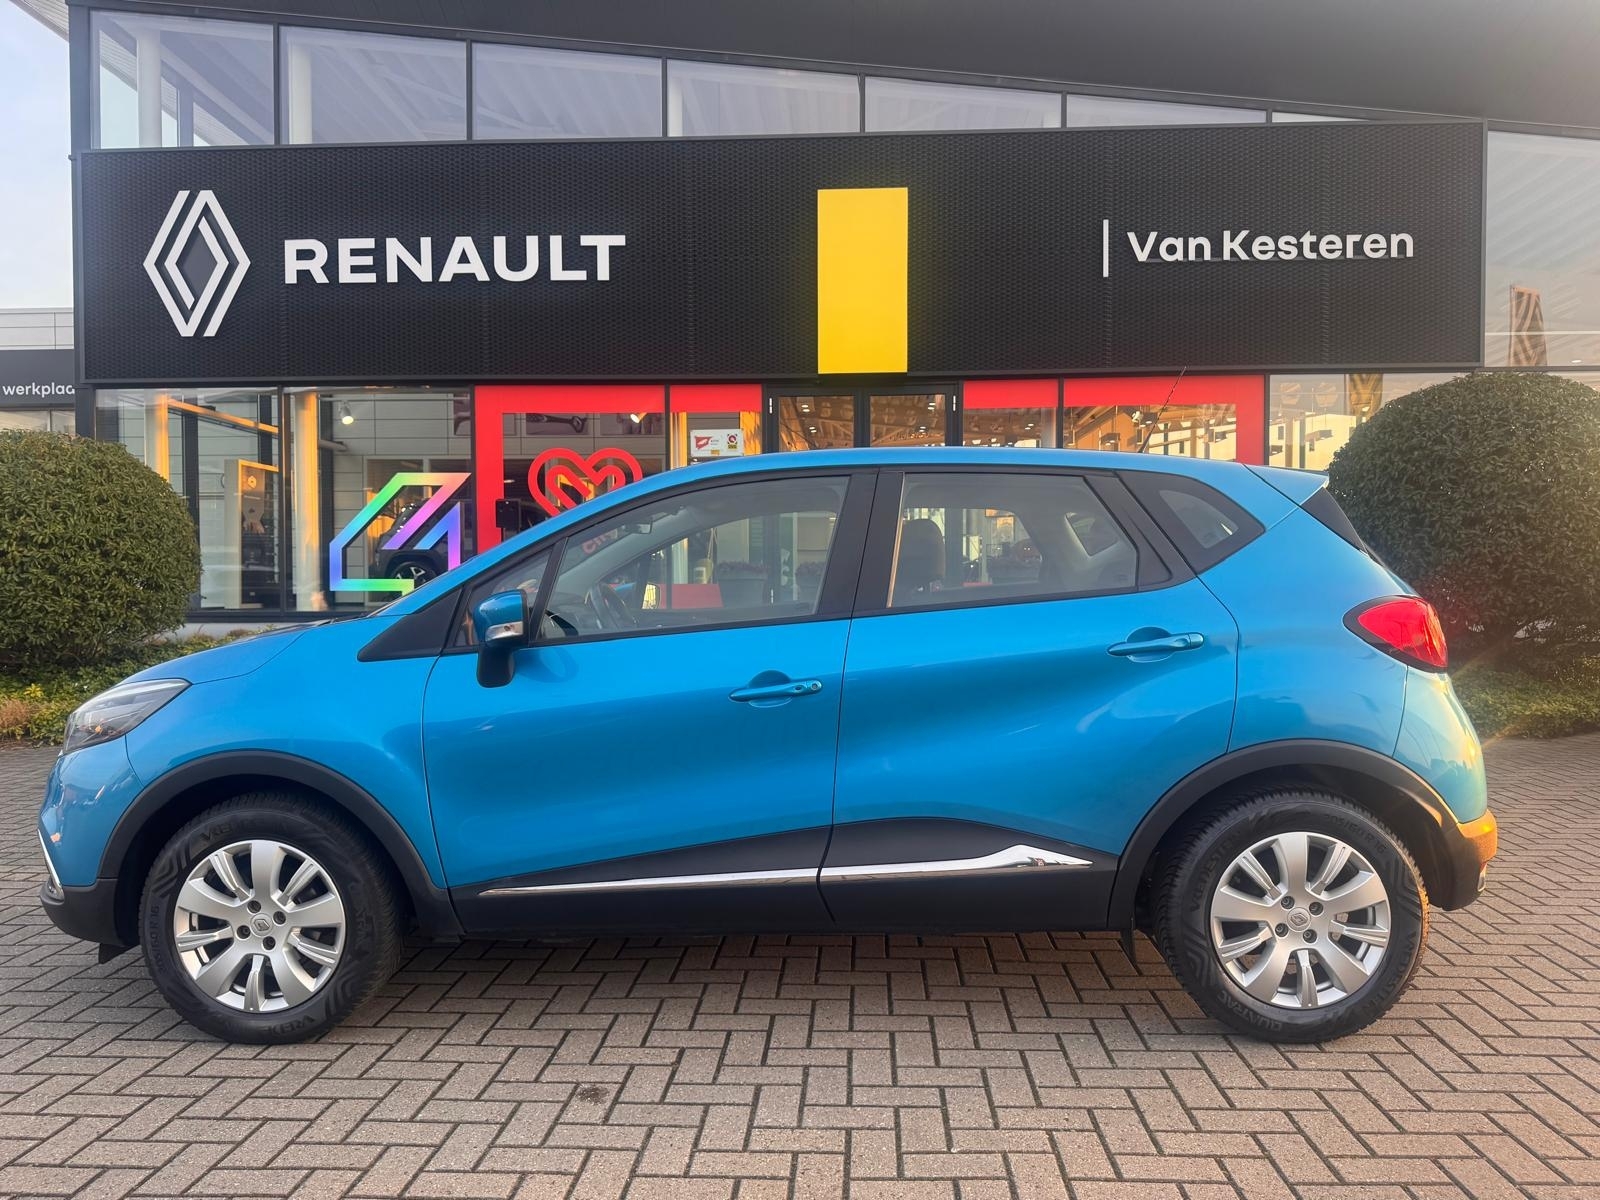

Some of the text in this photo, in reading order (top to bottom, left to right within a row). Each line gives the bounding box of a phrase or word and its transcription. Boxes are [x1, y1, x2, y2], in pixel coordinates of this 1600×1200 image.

[285, 235, 625, 283] RENAULT
[1128, 231, 1413, 261] Van Kesteren
